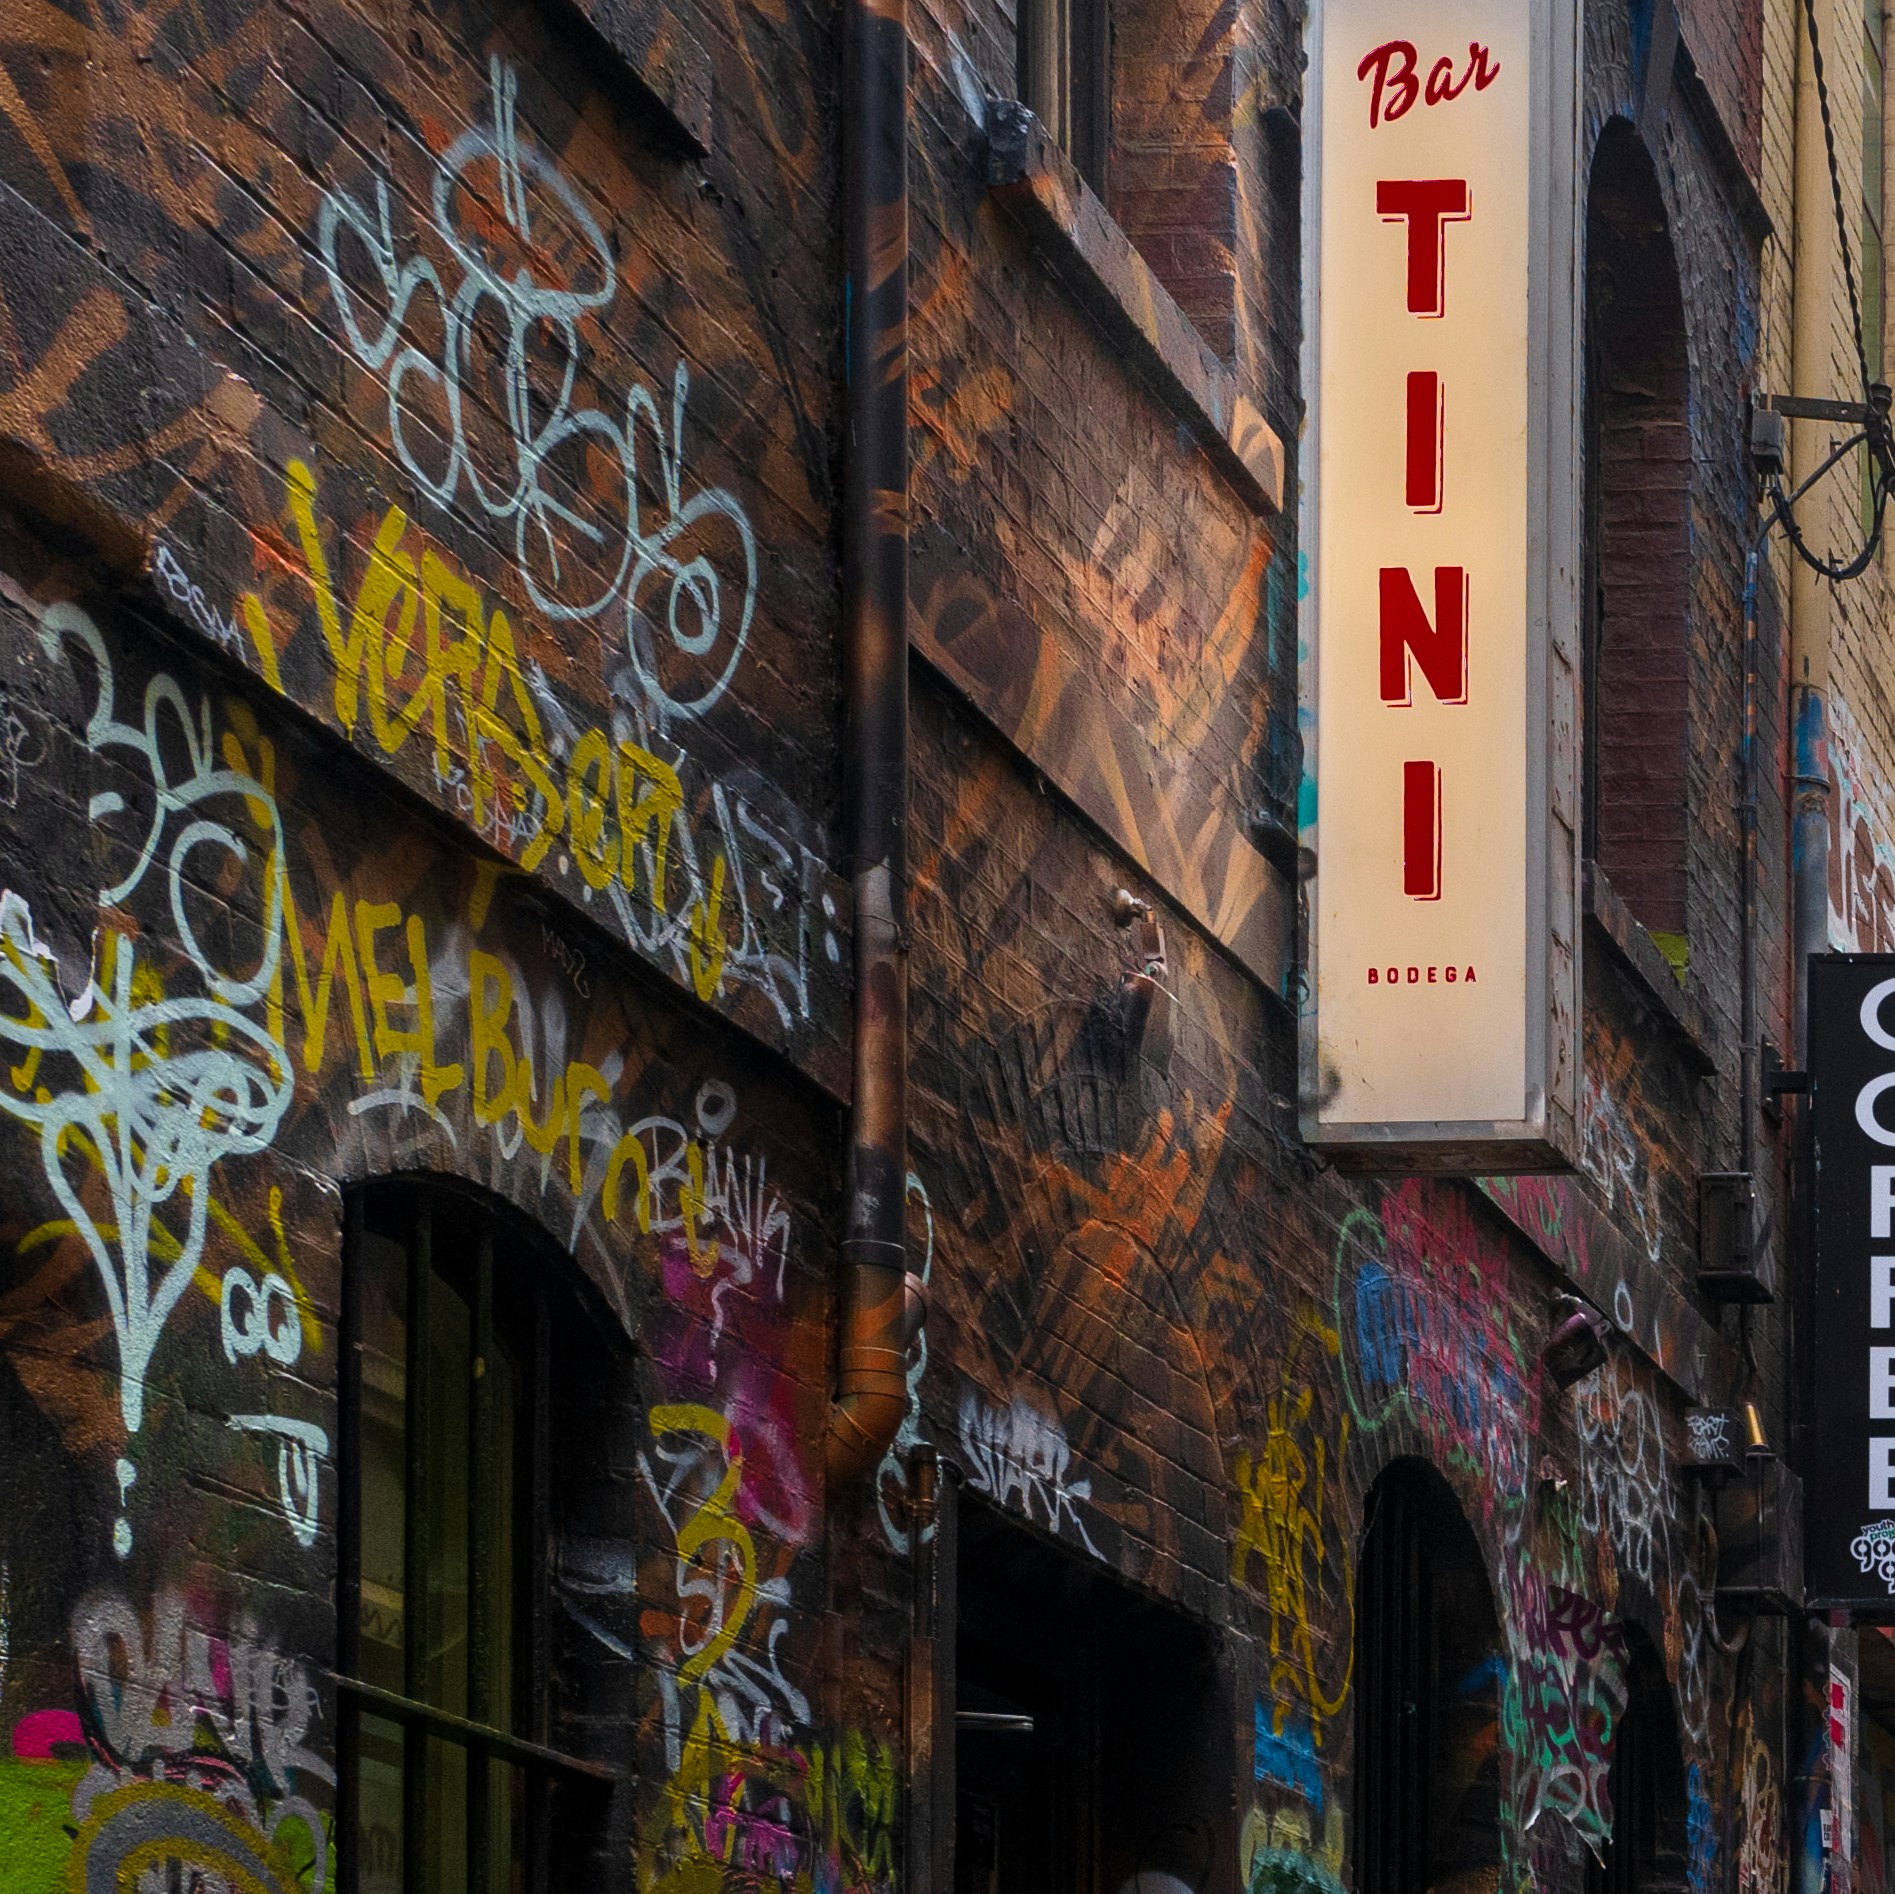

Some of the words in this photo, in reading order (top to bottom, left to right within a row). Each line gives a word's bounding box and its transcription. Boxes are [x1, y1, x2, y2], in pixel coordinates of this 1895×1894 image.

[1357, 39, 1501, 130] Bar
[1376, 178, 1473, 902] TINI
[1366, 965, 1478, 986] BODEGA
[1861, 1519, 1895, 1536] youth
